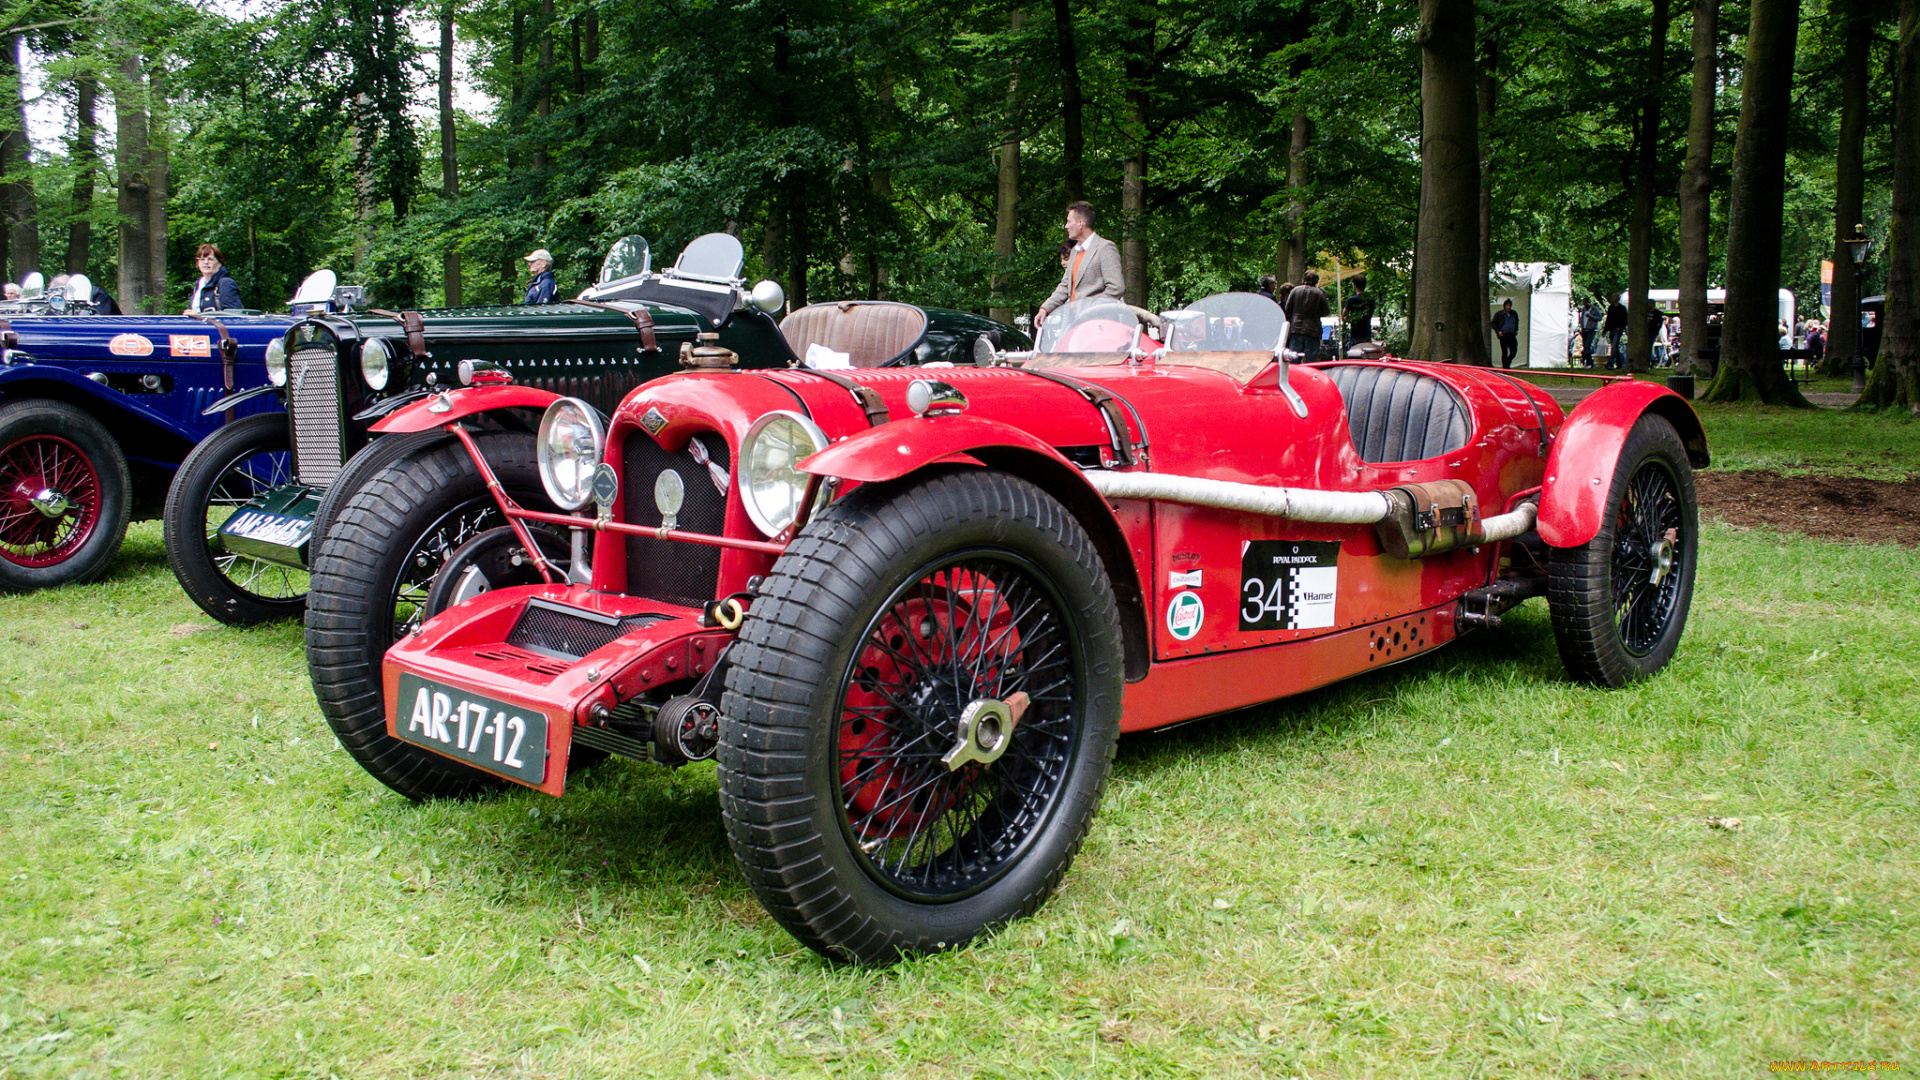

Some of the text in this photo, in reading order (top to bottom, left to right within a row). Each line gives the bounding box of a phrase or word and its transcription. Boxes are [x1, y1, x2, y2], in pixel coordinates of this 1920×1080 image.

[1272, 555, 1317, 564] ROYAL PADDOCK
[1242, 577, 1286, 623] 34
[1307, 592, 1334, 601] Hamer
[1175, 605, 1197, 626] Castrol
[408, 687, 527, 769] AR-17-12
